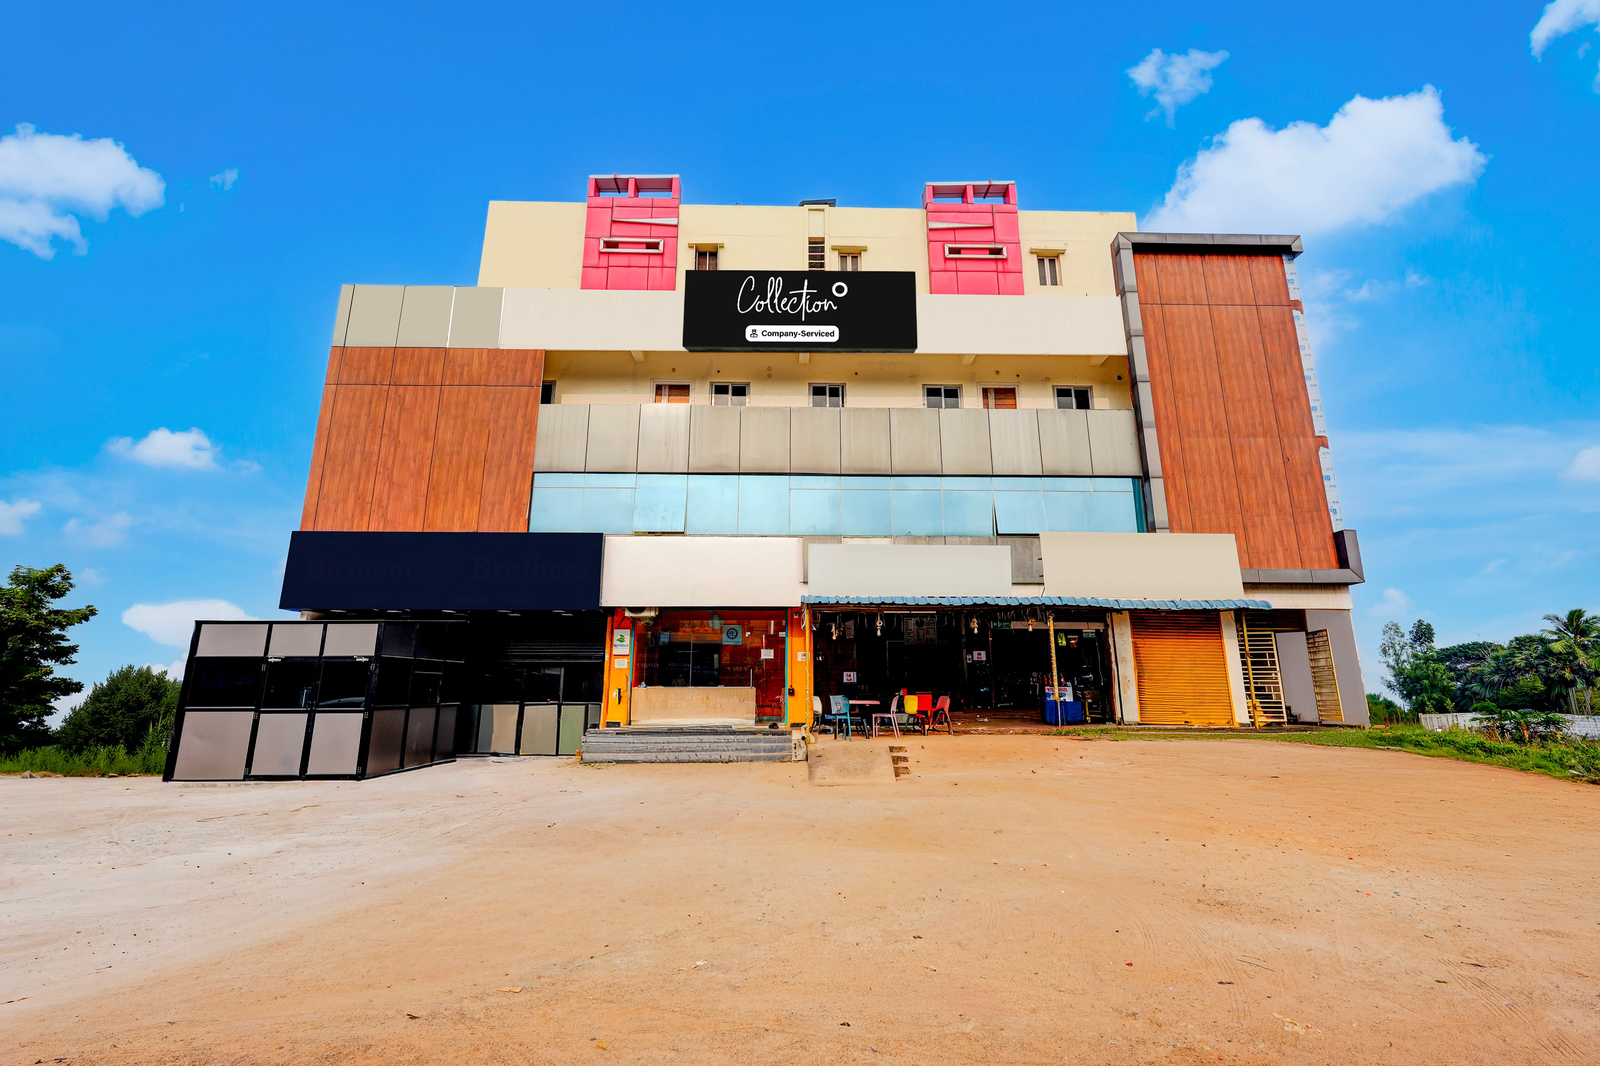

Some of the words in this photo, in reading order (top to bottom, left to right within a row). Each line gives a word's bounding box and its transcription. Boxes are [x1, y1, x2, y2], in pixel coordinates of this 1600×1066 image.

[737, 276, 837, 321] Collection
[761, 329, 835, 339] Company-Serviced
[471, 553, 590, 583] Brothers
